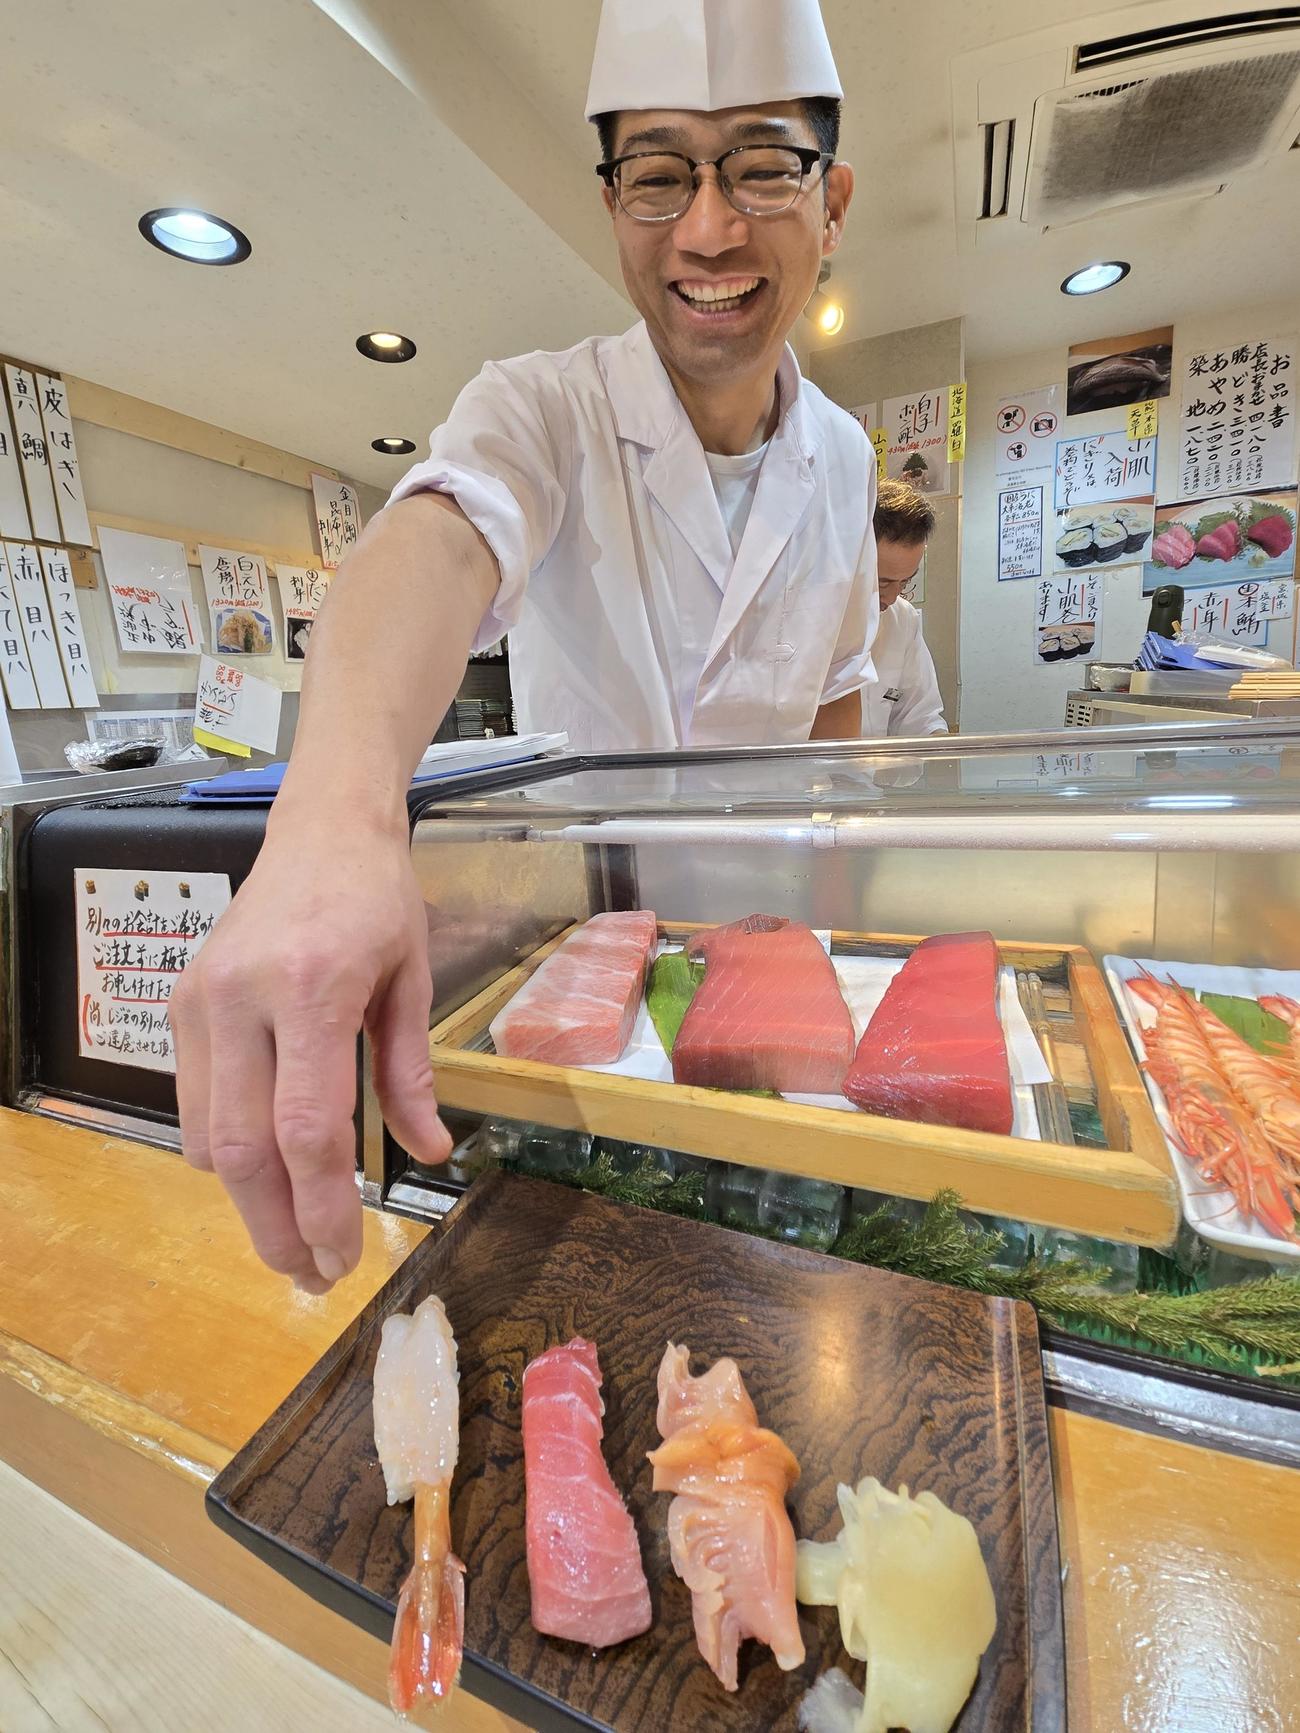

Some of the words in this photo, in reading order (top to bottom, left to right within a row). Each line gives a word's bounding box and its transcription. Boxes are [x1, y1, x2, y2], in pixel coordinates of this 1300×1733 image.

[1185, 353, 1209, 418] 築地
[1207, 352, 1229, 416] あやめ
[1231, 344, 1250, 413] 勝どき
[1249, 342, 1269, 406] 店長おまかせ
[1268, 354, 1290, 429] お品書
[13, 378, 48, 465] 真鯛
[914, 393, 934, 434] 白子
[950, 387, 964, 453] 北海道羅臼
[1104, 451, 1124, 487] 入荷
[1127, 439, 1151, 478] 小肌
[339, 486, 357, 543] 金目鯛
[14, 555, 51, 643] 赤貝
[212, 556, 241, 599] 唐揚げ
[289, 576, 305, 604] 刺身
[1038, 581, 1053, 622] あります
[1047, 577, 1081, 626] 小肌巻
[48, 562, 88, 677] ほっき貝
[1198, 592, 1223, 633] 赤身
[93, 939, 195, 973] ご注文前に板前
[96, 1029, 174, 1058] ご遠慮させて頂
